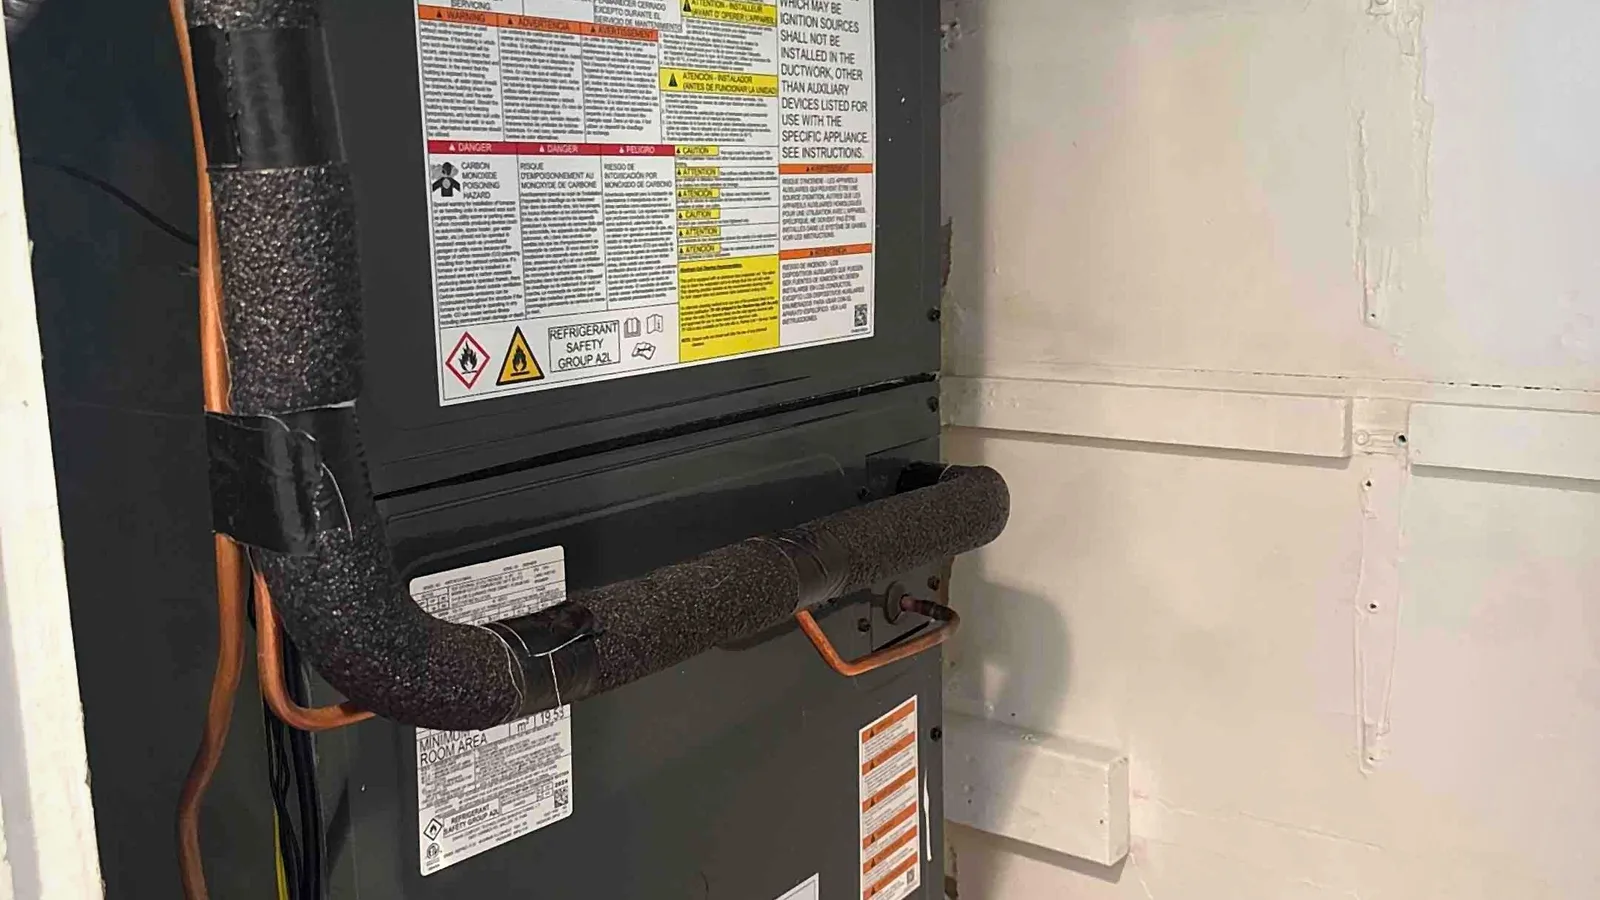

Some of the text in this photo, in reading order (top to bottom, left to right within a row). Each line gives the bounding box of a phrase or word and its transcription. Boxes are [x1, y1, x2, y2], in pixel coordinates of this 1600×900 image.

[780, 0, 842, 15] WHICH MAY BE
[446, 10, 486, 22] WARNING
[780, 12, 859, 33] IGNITION SOURCES
[780, 29, 808, 44] SHALL
[810, 32, 827, 45] NOT
[829, 35, 841, 47] BE
[781, 47, 855, 65] INSTALLED IN THE
[781, 63, 863, 81] DUCTWORK, OTHER
[781, 80, 850, 95] THAN AUXILIARY
[782, 97, 868, 112] DEVICES LISTED FOR
[782, 113, 842, 127] USE WITH THE
[782, 130, 821, 142] SPECIFIC
[458, 143, 492, 152] DANGER
[547, 145, 578, 153] DANGER
[626, 145, 655, 153] PELIGRO
[682, 146, 709, 154] CAUTION
[782, 147, 864, 159] SEE INSTRUCTIONS.
[461, 162, 490, 170] CARBON
[520, 162, 544, 170] RISQUE
[462, 171, 497, 179] MONOXIDE
[521, 181, 556, 189] MONOXYDE
[464, 191, 491, 199] HAZARD
[685, 209, 711, 218] CAUTION
[686, 226, 717, 235] ATTENTION
[550, 322, 617, 340] REFRIGERANT
[566, 338, 604, 353] SAFETY
[558, 352, 612, 369] GROUP A2L
[420, 732, 487, 767] ROOM AREA
[451, 804, 490, 823] REFRIGERANT
[443, 821, 466, 834] SAFETY
[467, 812, 488, 826] GROUP
